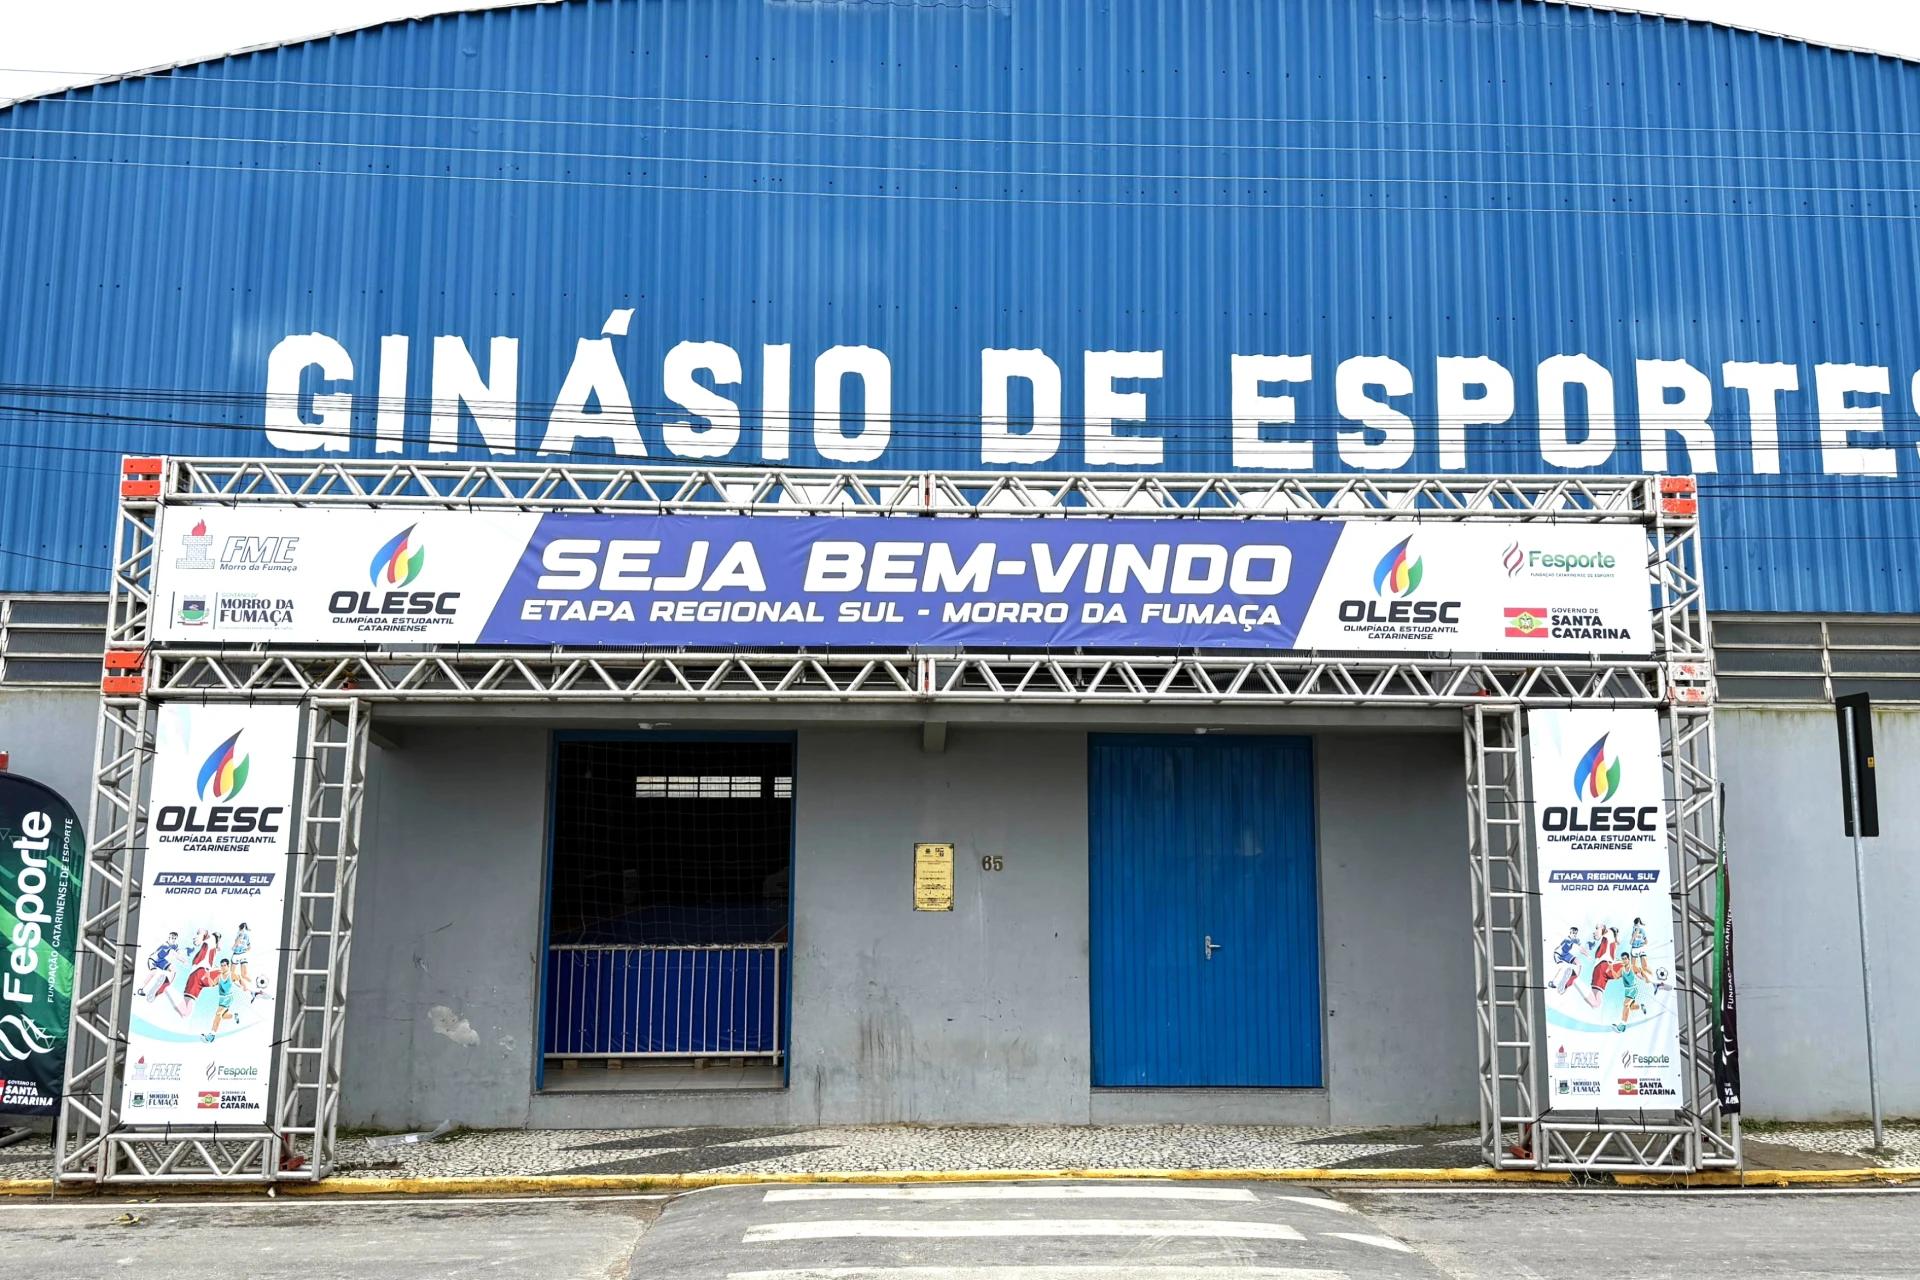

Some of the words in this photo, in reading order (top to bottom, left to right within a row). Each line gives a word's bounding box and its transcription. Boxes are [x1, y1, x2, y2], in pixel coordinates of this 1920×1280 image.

[265, 308, 892, 463] GINÁSIO
[980, 348, 1164, 466] DE
[1229, 353, 1920, 478] ESPORTE
[220, 536, 299, 563] FME
[536, 539, 766, 592] SEJA
[803, 541, 1293, 595] BEM-VINDO
[1529, 551, 1615, 571] Fesporte
[220, 563, 246, 571] Morro
[249, 563, 260, 571] da
[262, 564, 297, 572] Fumaça
[221, 598, 271, 609] MORRO
[276, 599, 294, 609] DA
[328, 590, 461, 615] OLESC
[220, 609, 293, 626] FUMAÇA
[520, 600, 635, 621] ETAPA
[649, 601, 824, 623] REGIONAL
[838, 602, 904, 623] SUL
[942, 602, 1069, 624] MORRO
[1081, 603, 1128, 625] DA
[1141, 603, 1281, 632] FUMAÇA
[1338, 600, 1461, 624] OLESC
[332, 616, 388, 624] OLIMPÍADA
[392, 617, 454, 625] ESTUDANTIL
[1551, 615, 1603, 626] SANTA
[358, 624, 428, 632] CATARINENSE
[1551, 627, 1631, 640] CATARINA
[1368, 632, 1434, 640] CATARINENSE
[156, 805, 283, 833] OLESC
[1542, 806, 1658, 831] OLESC
[62, 818, 73, 862] ESPORTE
[159, 834, 213, 843] OLIMPÍADA
[216, 835, 276, 844] ESTUDANTIL
[1547, 833, 1597, 842] OLIMPÍADA
[1600, 834, 1656, 842] ESTUDANTIL
[183, 844, 250, 852] CATARINENSE
[982, 855, 1003, 871] 65
[61, 865, 69, 878] DE
[1553, 872, 1584, 880] ETAPA
[1586, 872, 1634, 880] REGIONAL
[1637, 872, 1656, 880] SUL
[159, 875, 192, 883] ETAPA
[195, 876, 246, 884] REGIONAL
[250, 876, 270, 884] SUL
[165, 887, 201, 895] MORRO
[221, 887, 261, 897] FUMAÇA
[1612, 884, 1649, 893] FUMAÇA
[3, 811, 52, 1003] Fesporte
[52, 880, 68, 948] CATARINENSE
[47, 950, 59, 1003] FUNDAÇÃO
[1633, 1054, 1669, 1065] Fesporte
[217, 1065, 258, 1077] Fesporte
[5, 1085, 38, 1096] SANTA
[3, 1095, 53, 1106] CATARINA
